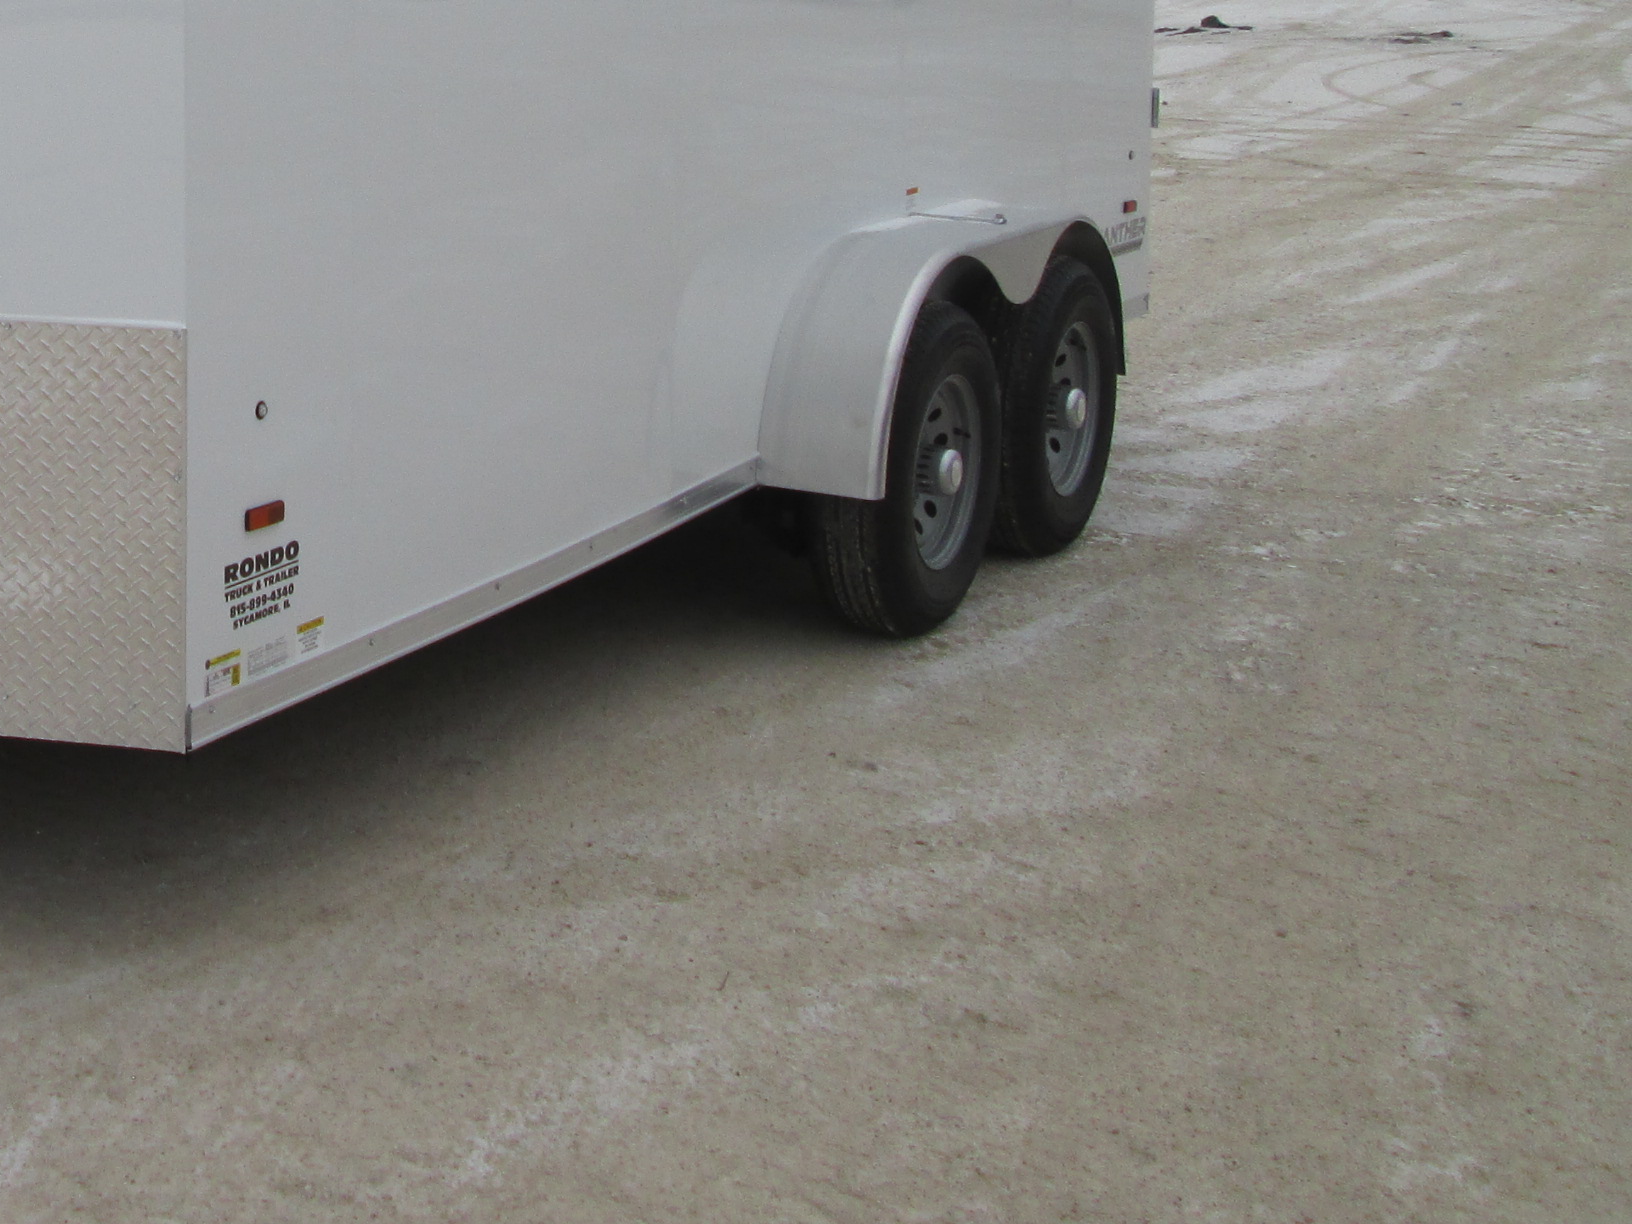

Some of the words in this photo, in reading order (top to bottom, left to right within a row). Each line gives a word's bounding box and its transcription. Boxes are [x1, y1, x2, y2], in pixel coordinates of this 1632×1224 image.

[224, 540, 300, 584] RONDO
[224, 584, 253, 602] TRUCK
[255, 579, 262, 591] &
[263, 565, 299, 587] TRAILER
[229, 583, 295, 618] 815-899-4340
[283, 599, 291, 610] IL
